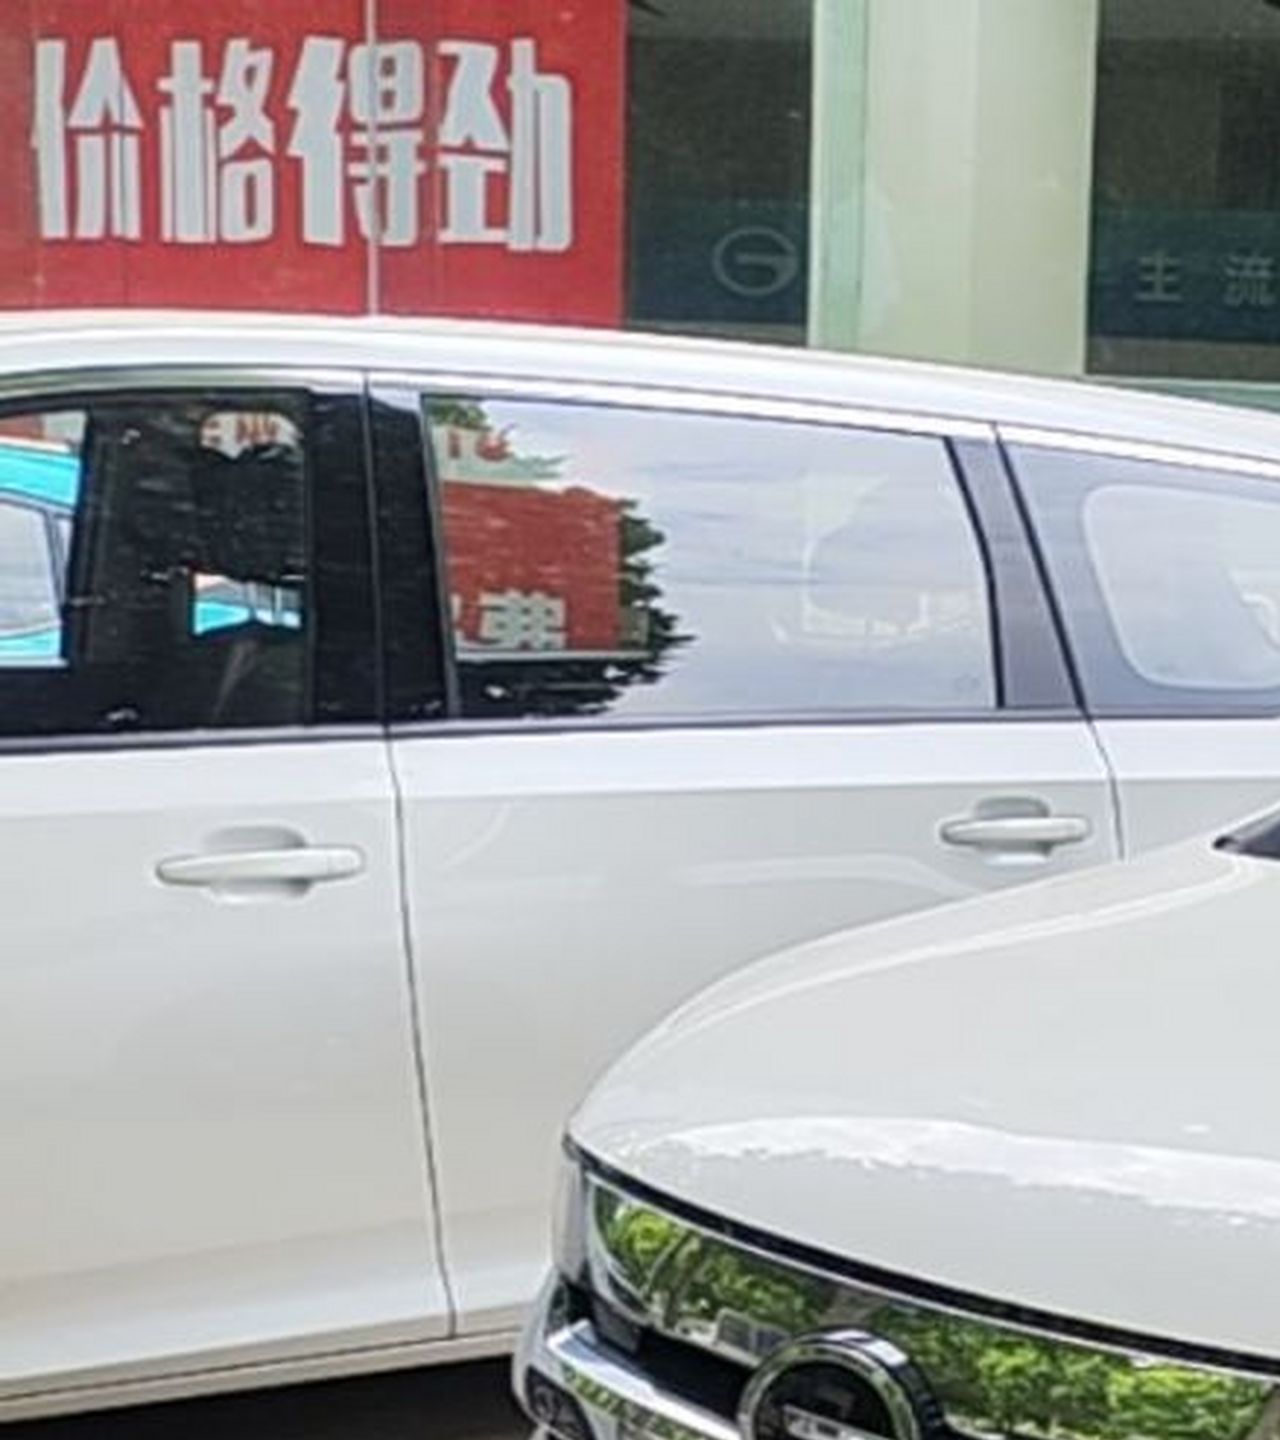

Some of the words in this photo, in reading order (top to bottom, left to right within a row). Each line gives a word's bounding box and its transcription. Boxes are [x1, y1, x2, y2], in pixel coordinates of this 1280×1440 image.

[31, 37, 573, 252] 价格得劲
[1133, 248, 1277, 310] 主流
